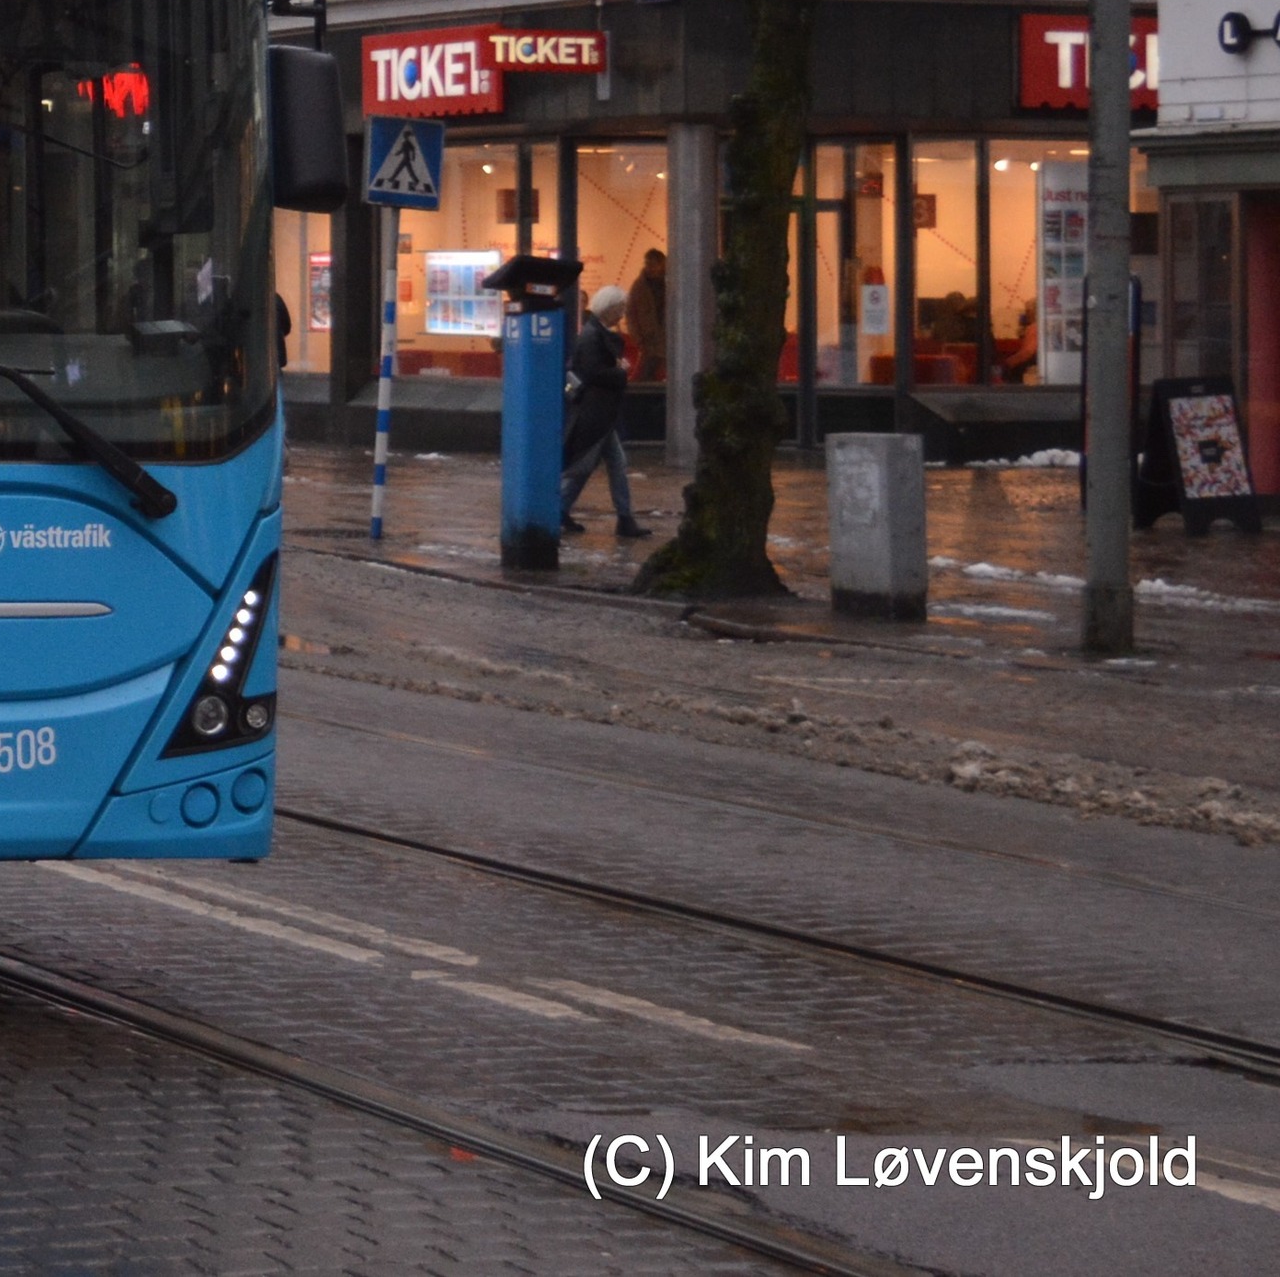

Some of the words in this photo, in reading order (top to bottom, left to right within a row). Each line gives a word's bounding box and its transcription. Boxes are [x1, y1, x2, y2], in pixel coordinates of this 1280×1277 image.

[488, 34, 596, 65] TICKET
[370, 40, 479, 102] TICKET
[9, 523, 112, 549] västtrafik
